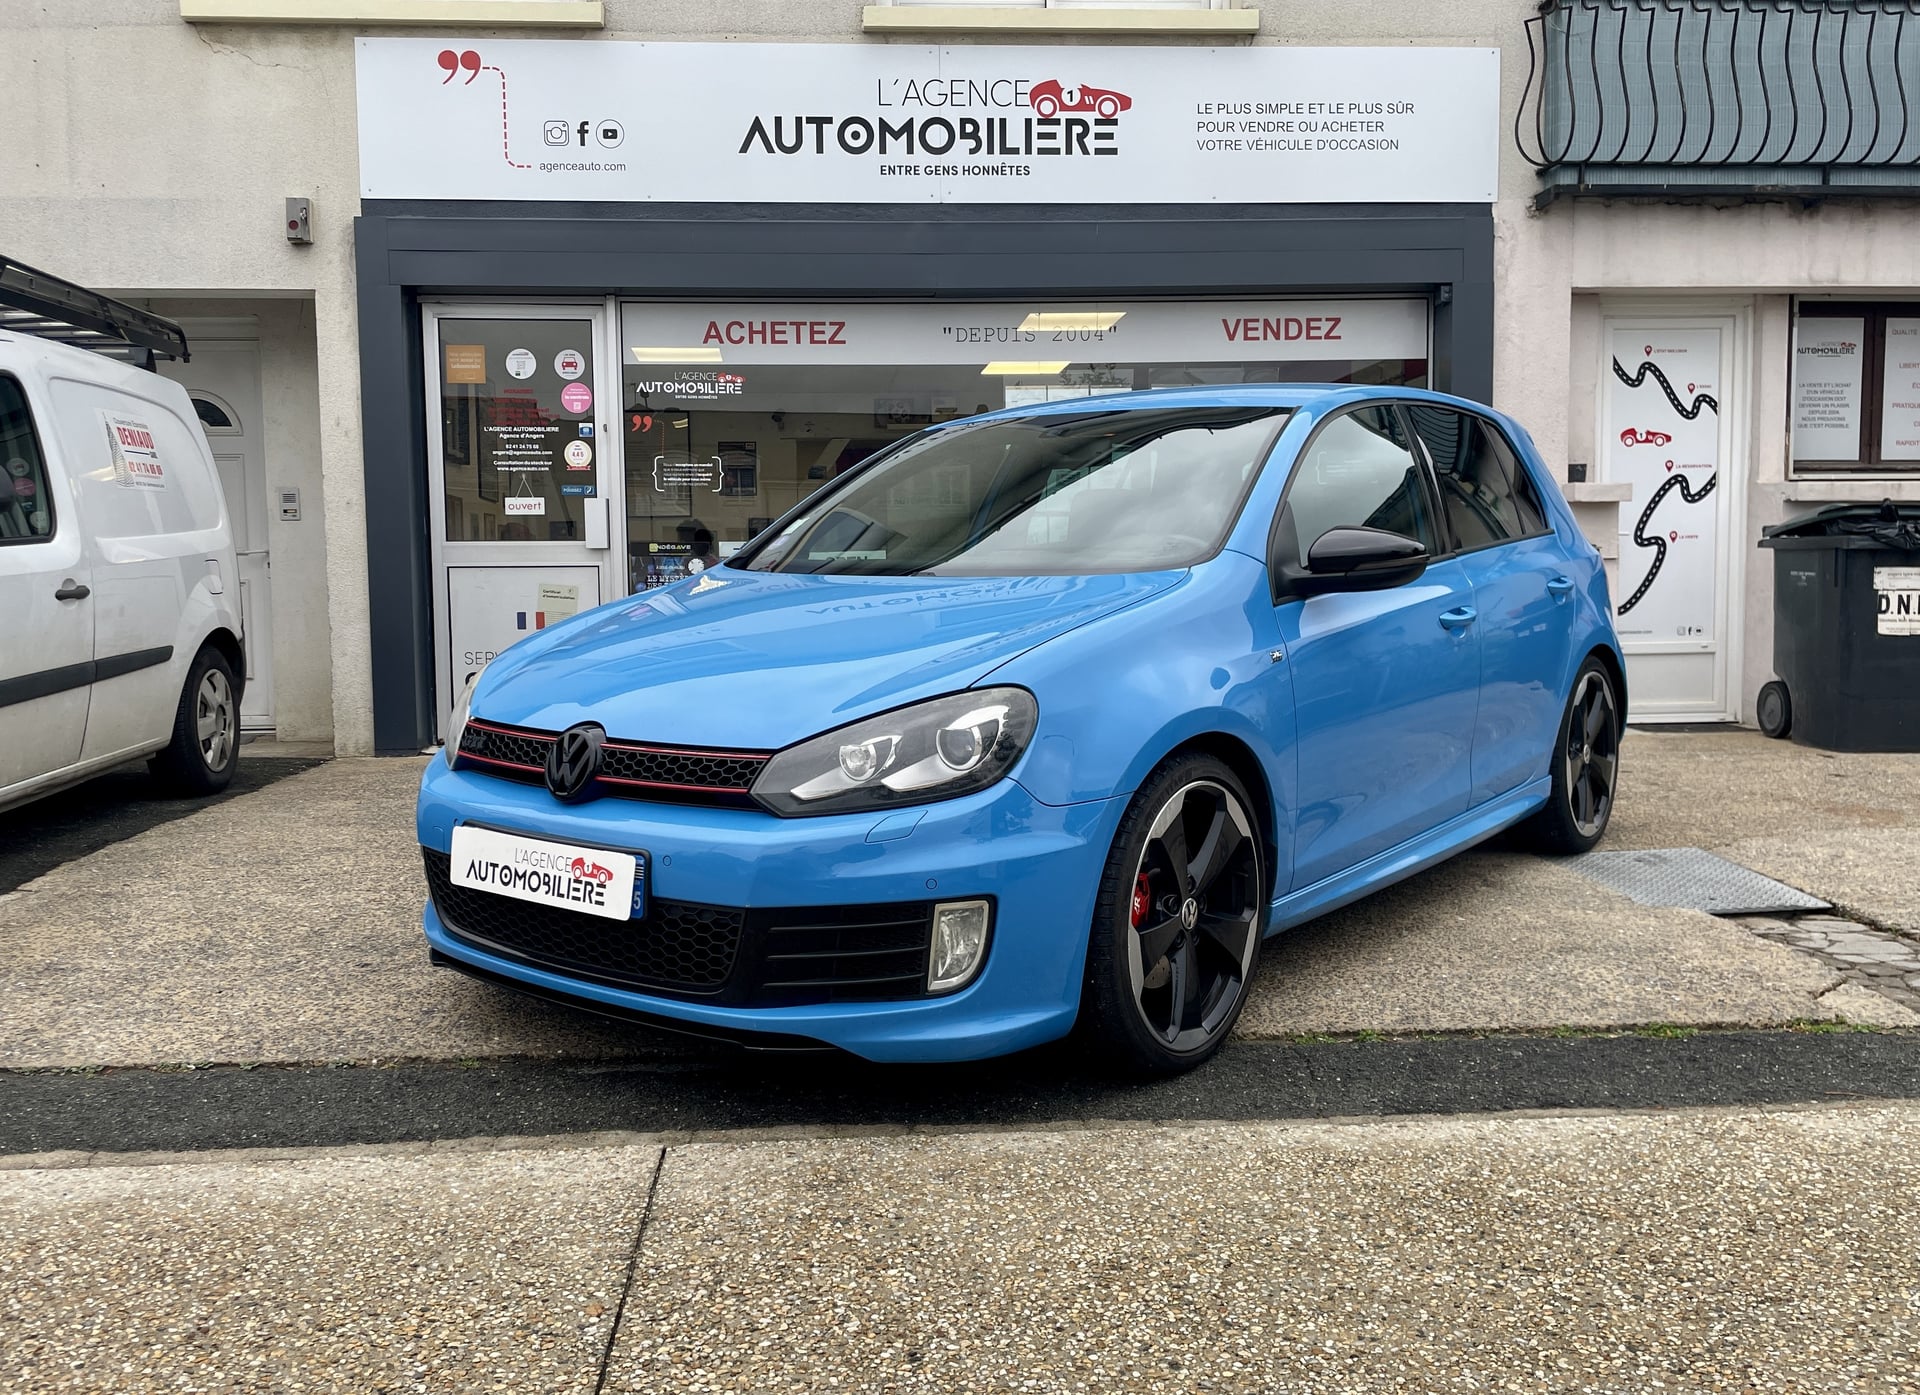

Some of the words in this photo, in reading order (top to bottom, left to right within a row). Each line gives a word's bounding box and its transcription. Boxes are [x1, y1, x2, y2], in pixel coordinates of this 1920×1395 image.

[878, 78, 1031, 107] L'AGENCE
[1066, 89, 1074, 102] 1
[1196, 103, 1213, 115] LE
[1217, 102, 1252, 115] PLUS
[1255, 102, 1304, 115] SIMPLE
[1308, 102, 1325, 114] ET
[1328, 102, 1344, 114] LE
[1348, 102, 1383, 114] PLUS
[1386, 100, 1415, 115] SÛR
[1197, 121, 1235, 133] POUR
[1239, 121, 1294, 133] VENDRE
[1298, 121, 1318, 133] OU
[1320, 121, 1384, 132] ACHETER
[1196, 139, 1242, 151] VOTRE
[1246, 136, 1313, 151] VÉHICULE
[1316, 138, 1399, 151] D'OCCASION
[539, 161, 626, 173] agenceauto.com
[879, 165, 921, 176] ENTRE
[924, 165, 959, 176] GENS
[962, 162, 1031, 176] HONNÊTES
[702, 320, 847, 345] ACHETEZ
[1222, 317, 1343, 341] VENDEZ
[674, 371, 718, 381] L'AGENCE
[116, 426, 155, 450] DENIAUD
[508, 502, 542, 511] ouvert
[1878, 593, 1920, 615] D.N.
[514, 847, 573, 874] L'AGENCE
